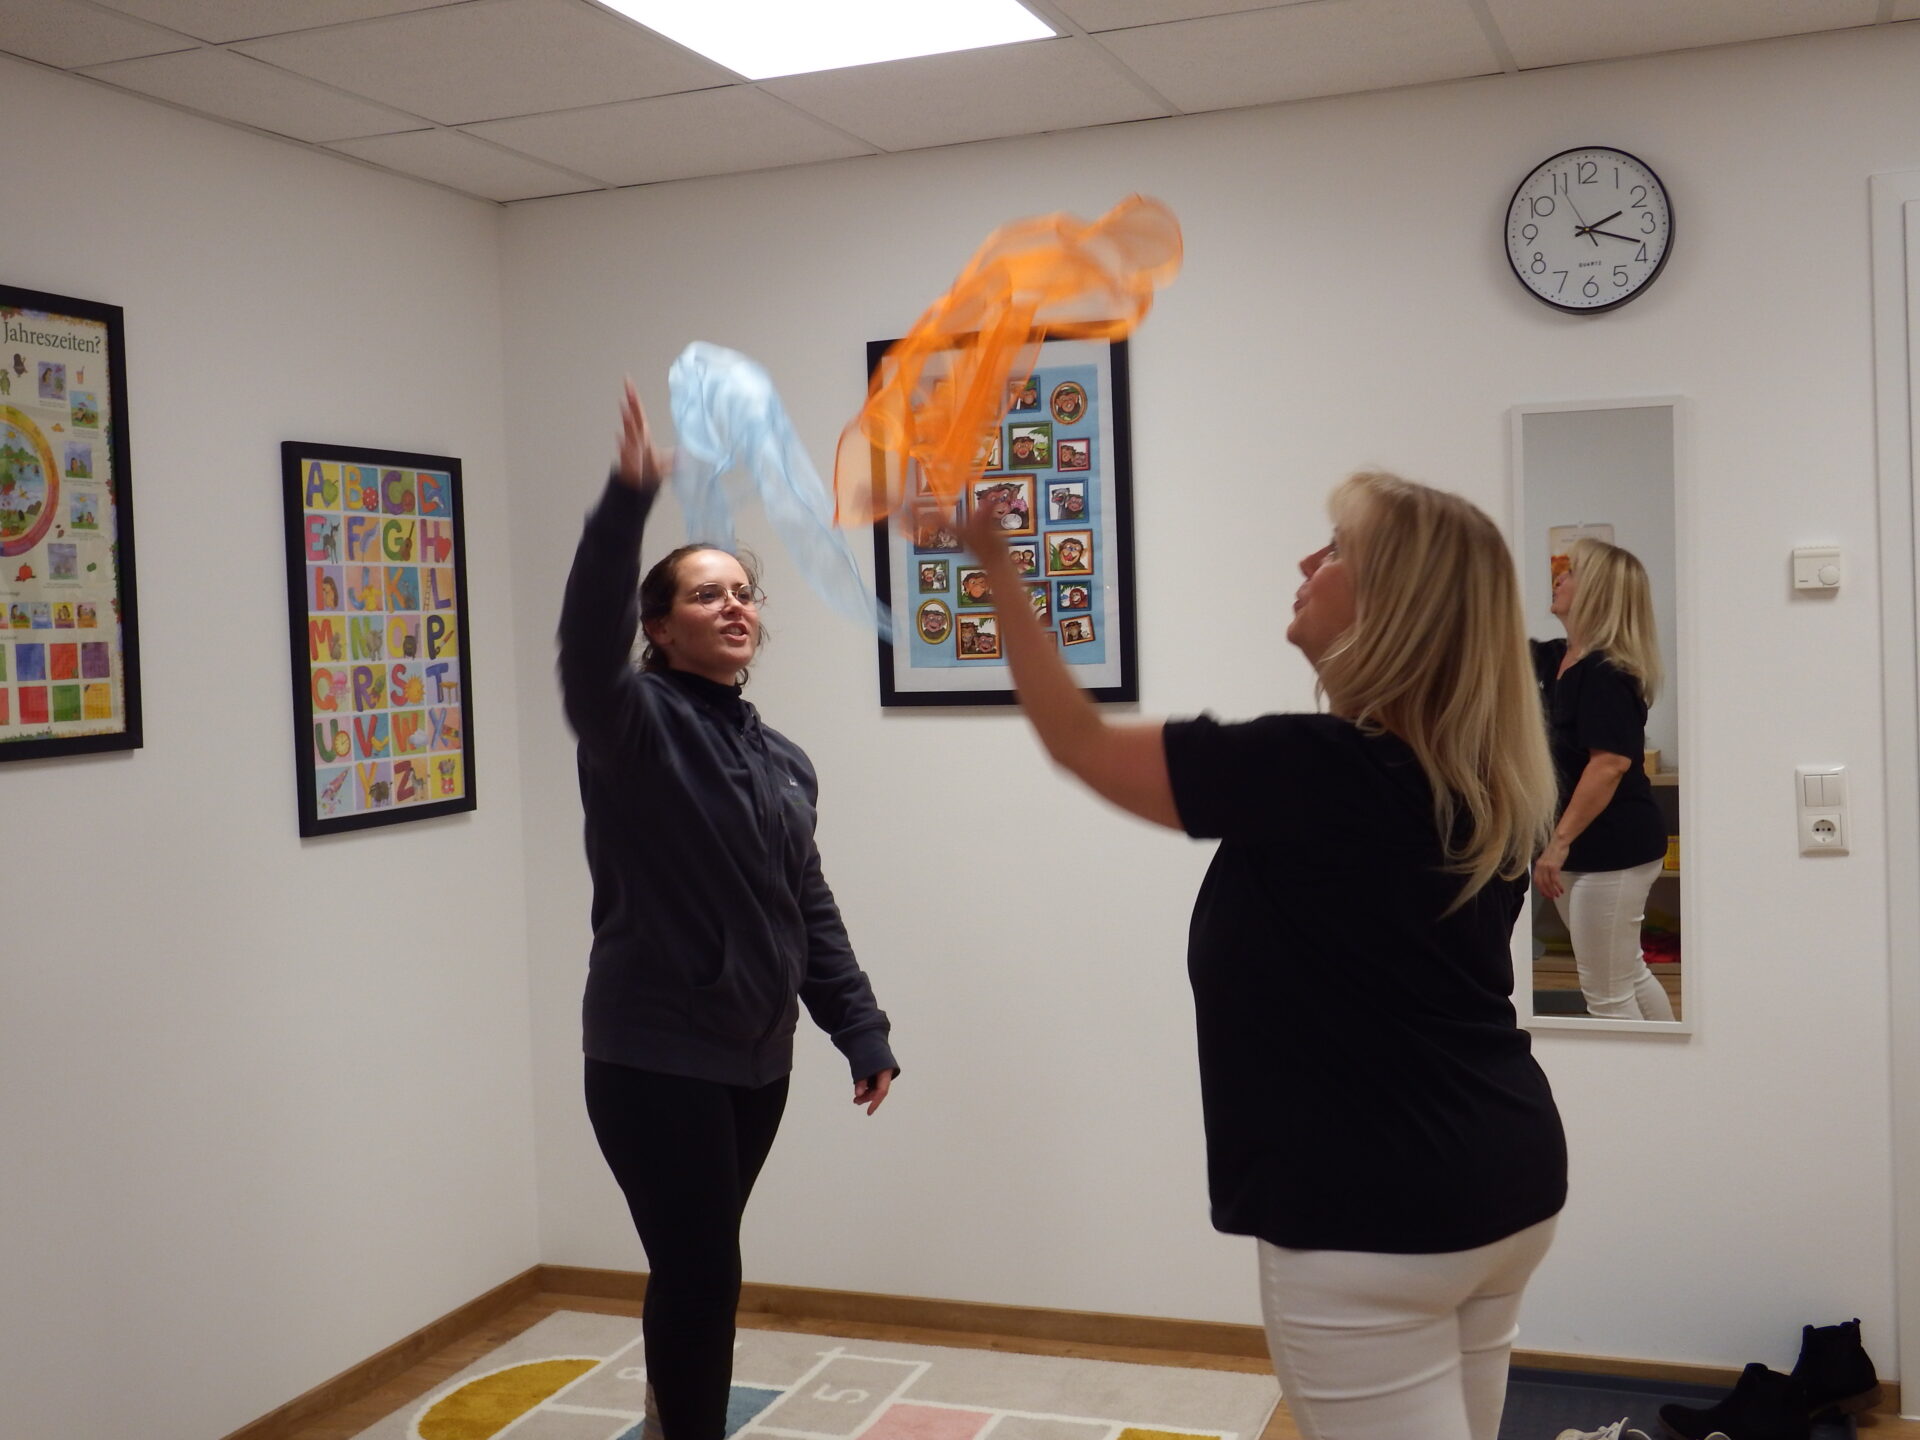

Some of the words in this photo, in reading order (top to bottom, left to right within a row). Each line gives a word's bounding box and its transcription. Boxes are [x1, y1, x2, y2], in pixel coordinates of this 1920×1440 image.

[1552, 172, 1568, 196] 11
[1576, 161, 1599, 185] 12
[1613, 167, 1620, 190] 1
[1529, 195, 1556, 220] 10
[1630, 185, 1647, 209] 2
[1522, 223, 1539, 247] 9
[1640, 211, 1656, 235] 3
[1531, 251, 1547, 275] 8
[1578, 259, 1603, 269] QUARTZ
[1634, 241, 1649, 264] 4
[1552, 270, 1569, 294] 7
[1582, 275, 1600, 298] 6
[1612, 264, 1629, 288] 5
[3, 320, 102, 354] Jahreszeiten?
[305, 461, 328, 508] A
[344, 465, 364, 510] B
[381, 470, 405, 515] C
[304, 514, 329, 561] E
[347, 515, 366, 561] F
[382, 519, 406, 562] G
[418, 518, 445, 563] H
[314, 566, 324, 611] I
[348, 566, 371, 611] J
[384, 566, 407, 614] K
[430, 567, 451, 610] L
[309, 618, 333, 661] M
[350, 616, 371, 661] N
[387, 615, 408, 659] O
[426, 615, 446, 661] P
[312, 667, 338, 712] Q
[353, 665, 376, 712] R
[390, 663, 409, 707] S
[425, 662, 449, 703] T
[315, 718, 339, 763] U
[353, 714, 378, 758] V
[392, 712, 419, 753] W
[428, 707, 449, 750] X
[356, 761, 378, 809] Y
[394, 760, 415, 802] Z
[812, 1383, 871, 1404] 5
